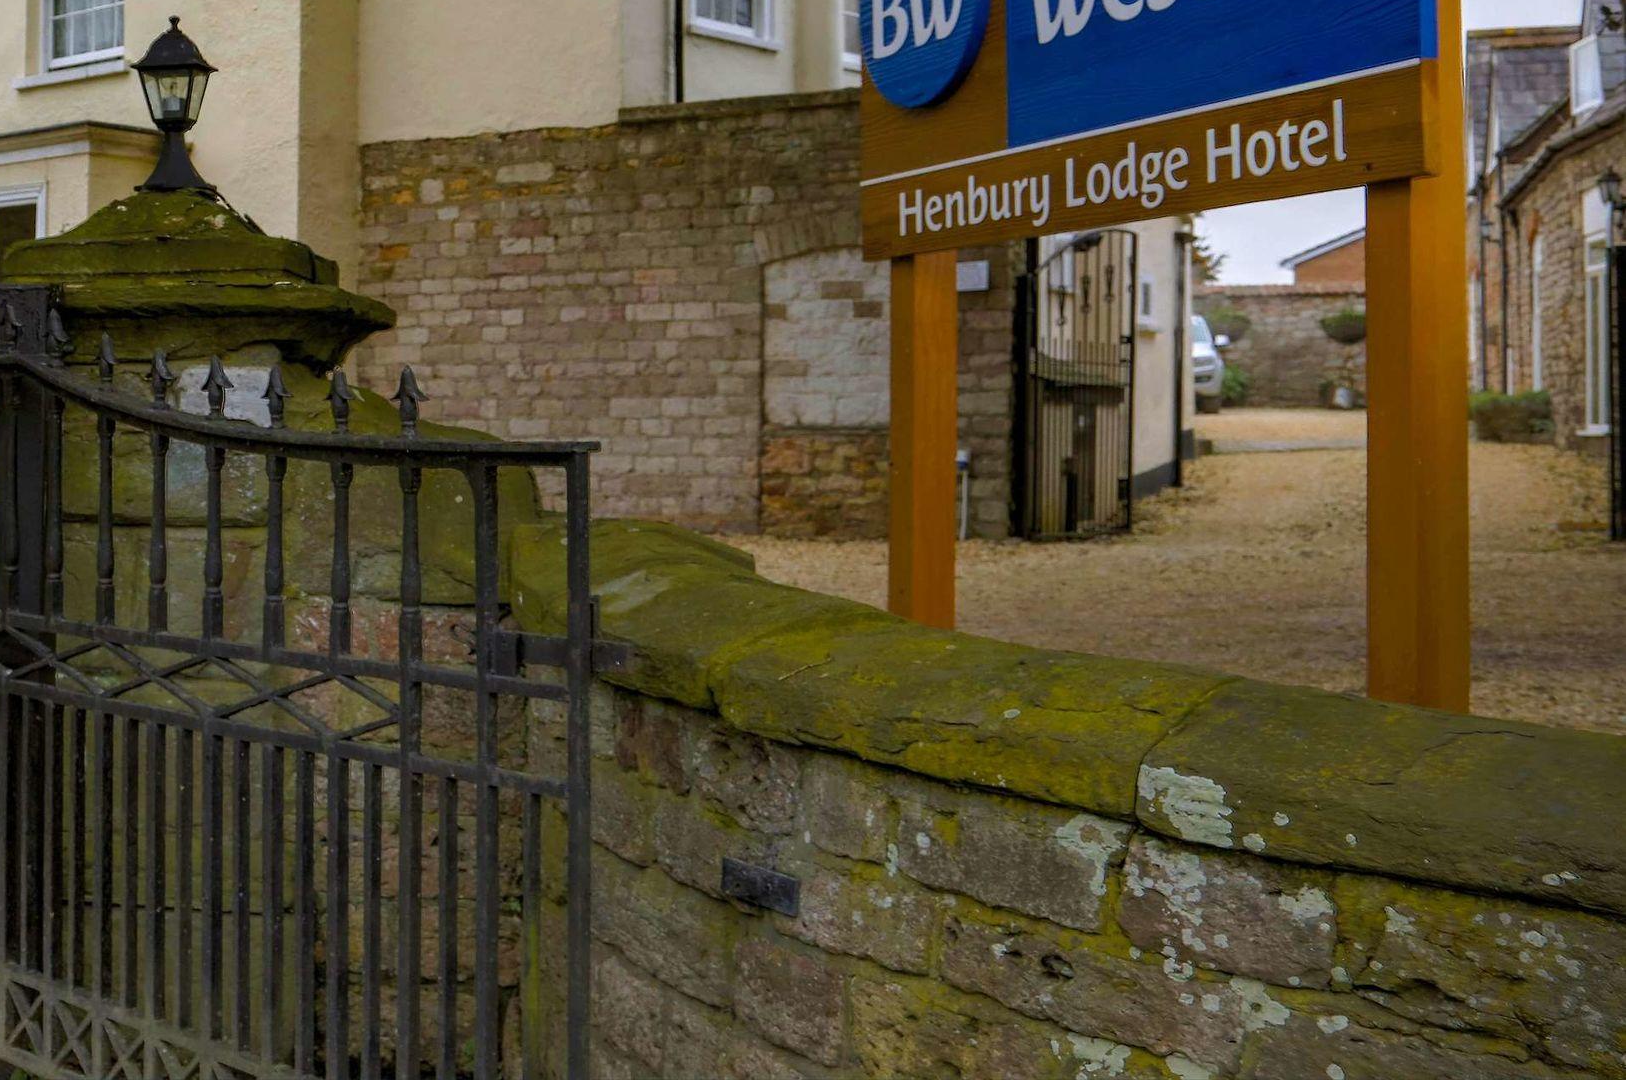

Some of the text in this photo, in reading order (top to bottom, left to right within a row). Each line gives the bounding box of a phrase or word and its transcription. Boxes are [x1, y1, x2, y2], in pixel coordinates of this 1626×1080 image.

[897, 98, 1348, 238] Henbury Lodge Hotel
